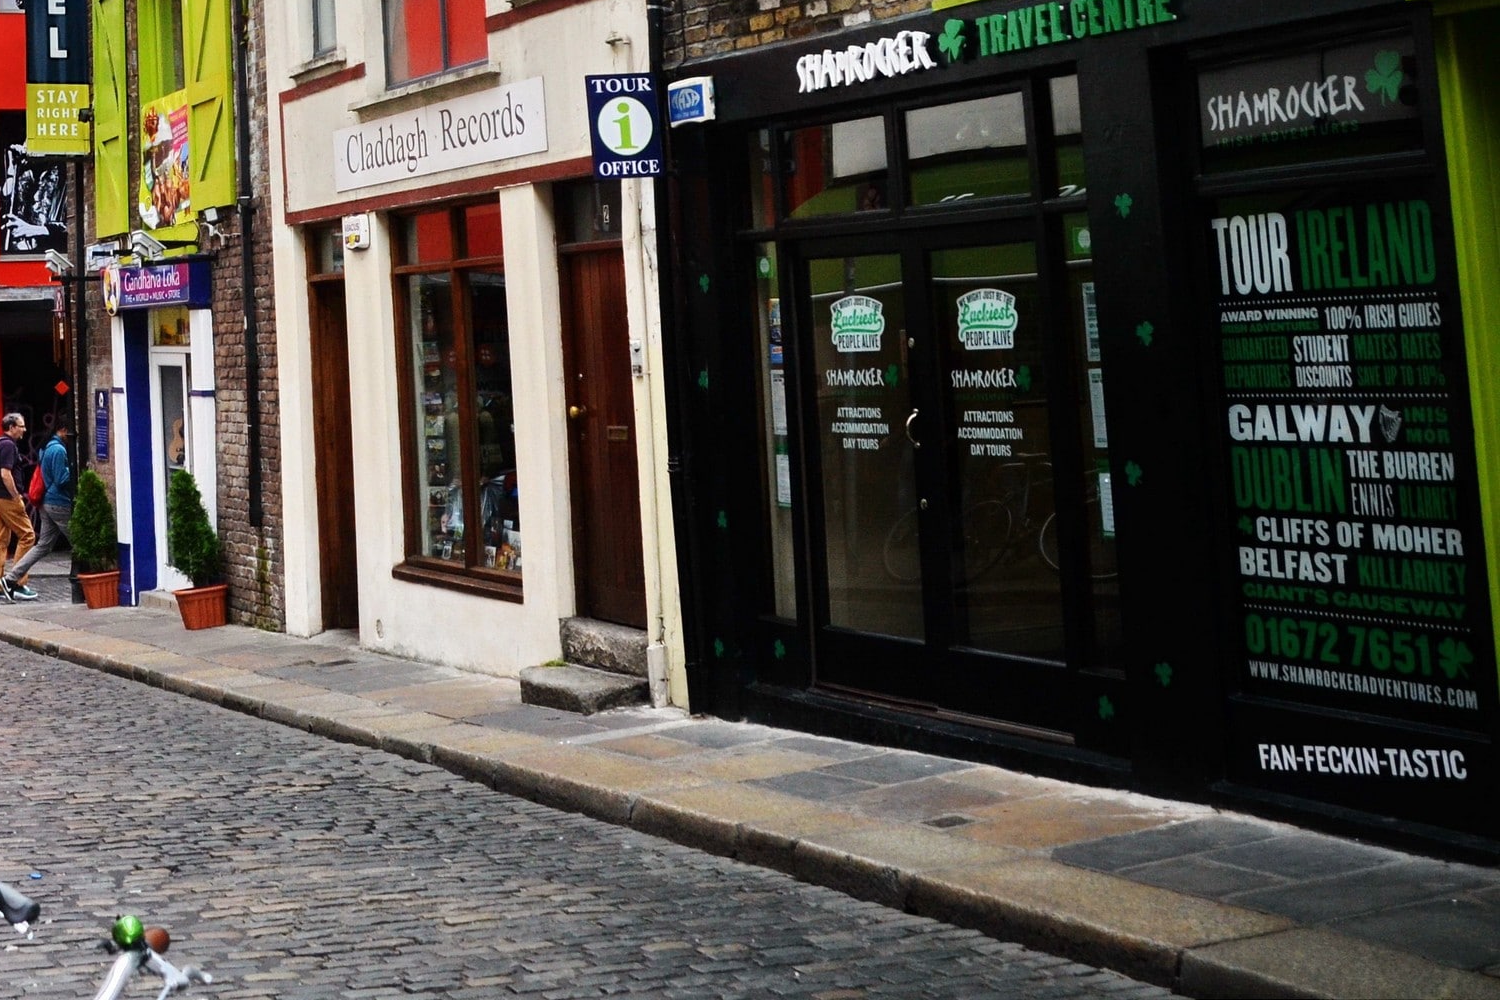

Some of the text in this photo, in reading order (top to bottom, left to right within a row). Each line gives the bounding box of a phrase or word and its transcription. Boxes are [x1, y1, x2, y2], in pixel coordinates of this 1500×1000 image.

[796, 30, 938, 94] SHAMROCKER
[975, 1, 1072, 57] TRAVEL
[36, 89, 79, 104] STAY
[591, 77, 652, 94] TOUR
[36, 107, 78, 119] RIGHT
[1206, 75, 1365, 132] SHAMROCKER
[37, 122, 78, 136] HERE
[346, 91, 526, 175] Claddagh Records
[1262, 119, 1360, 145] ADVENTURES
[599, 159, 661, 177] OFFICE
[1211, 199, 1438, 296] TOUR IRELAND
[124, 265, 180, 291] Gandharva Loka
[125, 289, 181, 303] THE WORLD MUSIC STORE
[833, 308, 879, 329] Luckiest
[960, 302, 1010, 325] Luckiest
[1220, 301, 1442, 330] AWARD WINNING 100% IRISH GUIDES
[965, 330, 1012, 346] PEOPLE ALIVE
[1250, 320, 1320, 333] ADVENTURES
[838, 334, 879, 348] PEOPLE ALIVE
[1221, 331, 1442, 363] GUARANTEED STUDENT MATES RATES
[825, 367, 885, 387] SHAMROCKER
[950, 367, 1017, 388] SHAMROCKER
[1223, 363, 1446, 388] DEPARTURES DISCOUNTS SAVE UP TO 10%
[837, 407, 882, 419] ATTRACTIONS
[963, 410, 1015, 423] ATTRACTIONS
[1228, 404, 1449, 443] GALWAY INIS
[831, 422, 890, 435] ACCOMMODATION
[957, 427, 1024, 440] ACCOMMODATION
[842, 437, 880, 450] DAY TOURS
[970, 444, 1012, 457] DAY TOURS
[1231, 447, 1456, 514] DUBLIN THE BURREN
[1351, 483, 1459, 521] ENNIS BLARNEY
[1255, 516, 1465, 557] CLIFFS OF MOHER
[1238, 546, 1468, 597] BELFAST KILLARNEY
[1241, 581, 1468, 621] GIANT'S CAUSEWAY
[1244, 613, 1434, 677] 01672 7651
[1248, 659, 1479, 711] WWW.SHAMROCKERADVENTURES.COM
[1257, 743, 1468, 780] FAN-FECKIN-TASTIC
